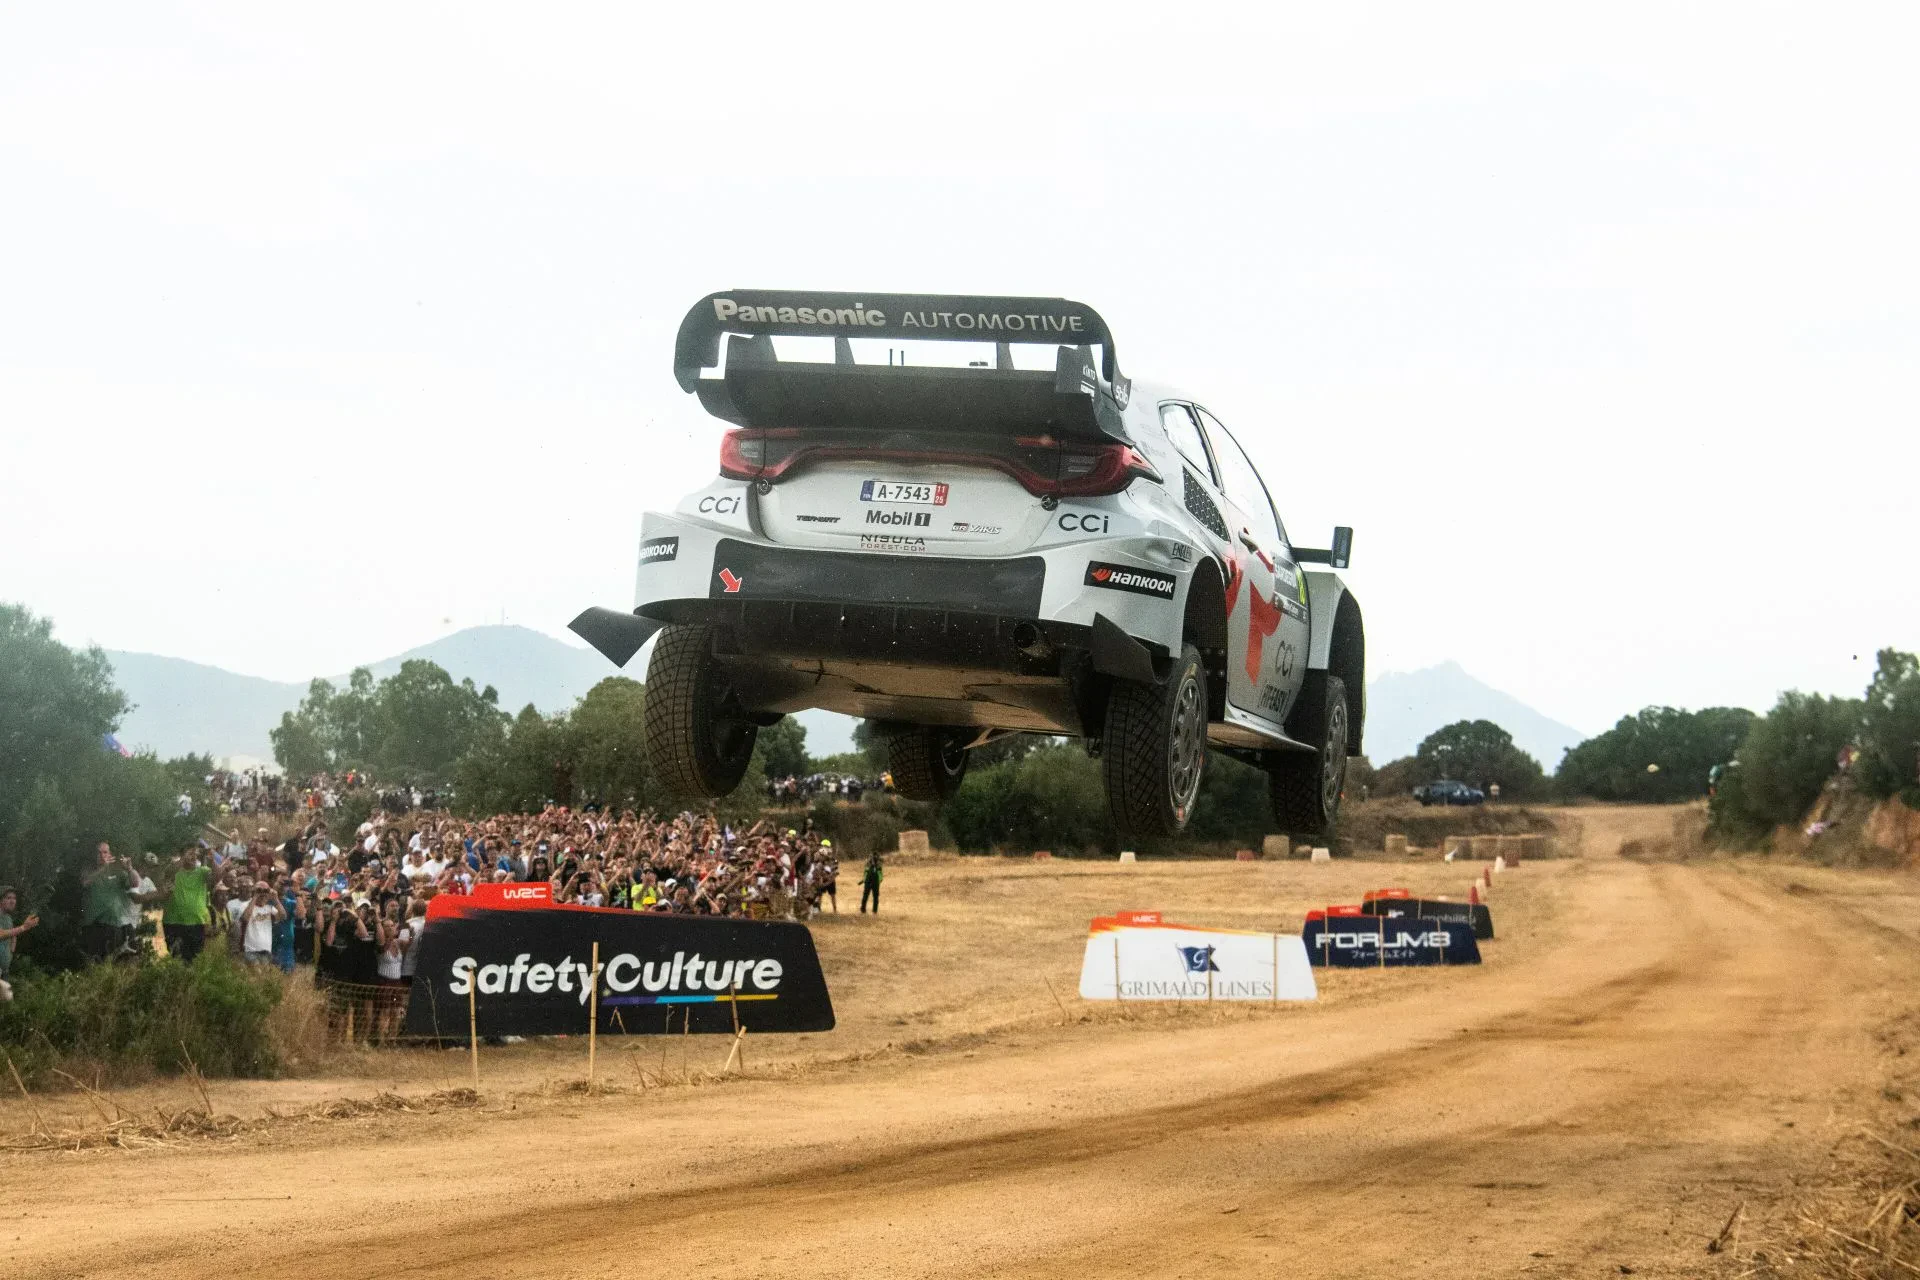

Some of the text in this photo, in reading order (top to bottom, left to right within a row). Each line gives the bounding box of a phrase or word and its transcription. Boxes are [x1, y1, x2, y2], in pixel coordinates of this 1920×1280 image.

[714, 299, 1084, 332] Panasonic AUTOMOTIVE
[877, 484, 931, 501] A-7543
[865, 509, 912, 525] Mobil
[861, 534, 925, 545] NISULA
[503, 888, 547, 899] WRC
[1316, 931, 1451, 949] FORUM8
[449, 951, 783, 1006] SafetyCulture
[1119, 980, 1272, 997] GRIMALD LINES
